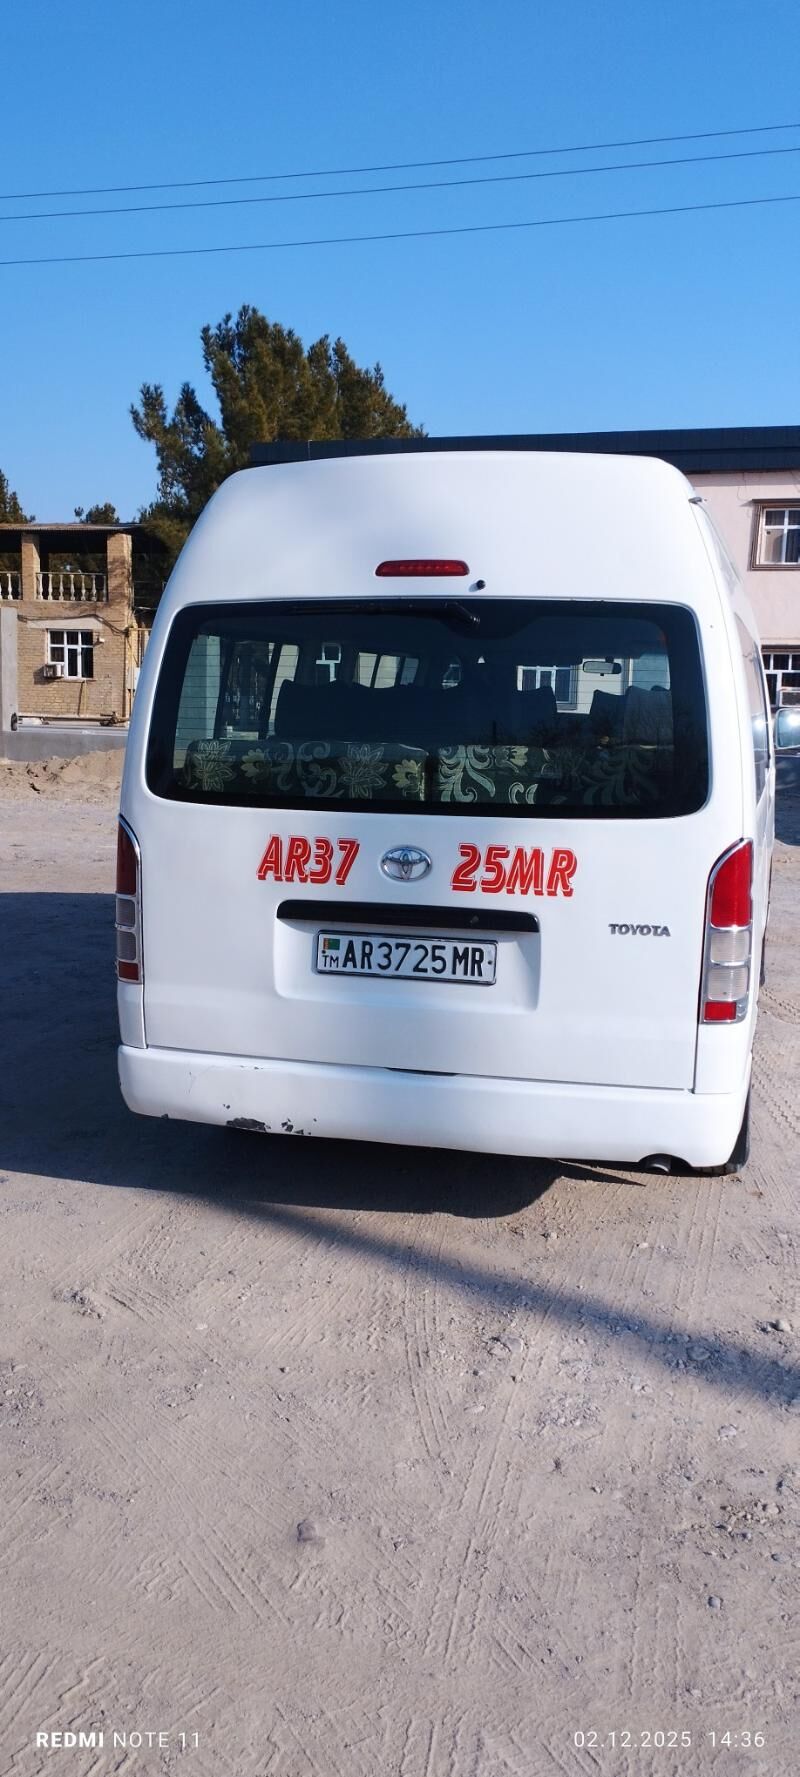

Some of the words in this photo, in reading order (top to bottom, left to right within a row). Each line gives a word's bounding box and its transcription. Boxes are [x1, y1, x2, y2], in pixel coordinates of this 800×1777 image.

[256, 833, 361, 886] AR37
[450, 842, 578, 897] 25MR
[608, 923, 671, 937] TOYOTA
[321, 954, 339, 969] TM
